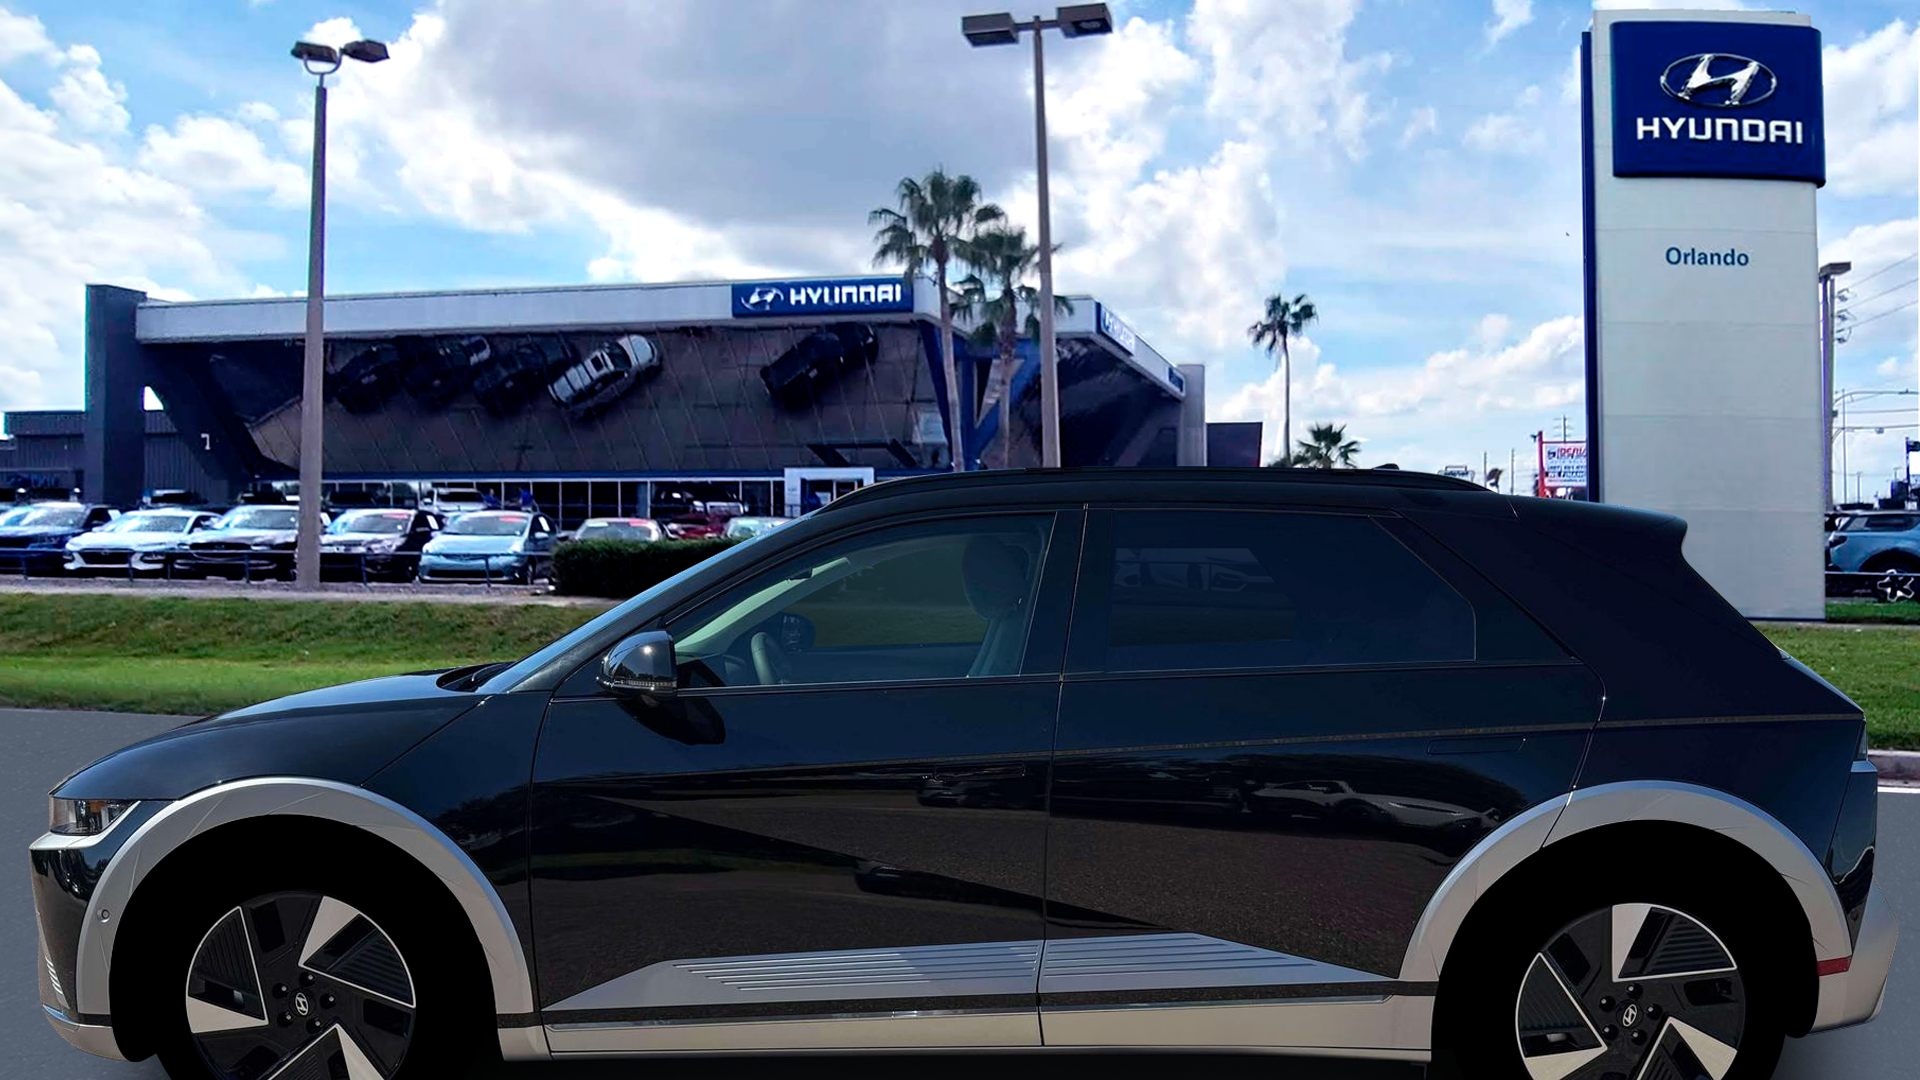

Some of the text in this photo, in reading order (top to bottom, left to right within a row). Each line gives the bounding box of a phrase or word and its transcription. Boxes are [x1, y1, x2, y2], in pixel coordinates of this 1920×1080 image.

[1636, 117, 1803, 143] HYUNDAI
[1665, 247, 1749, 266] Orlando
[789, 283, 901, 305] HYUNDAI
